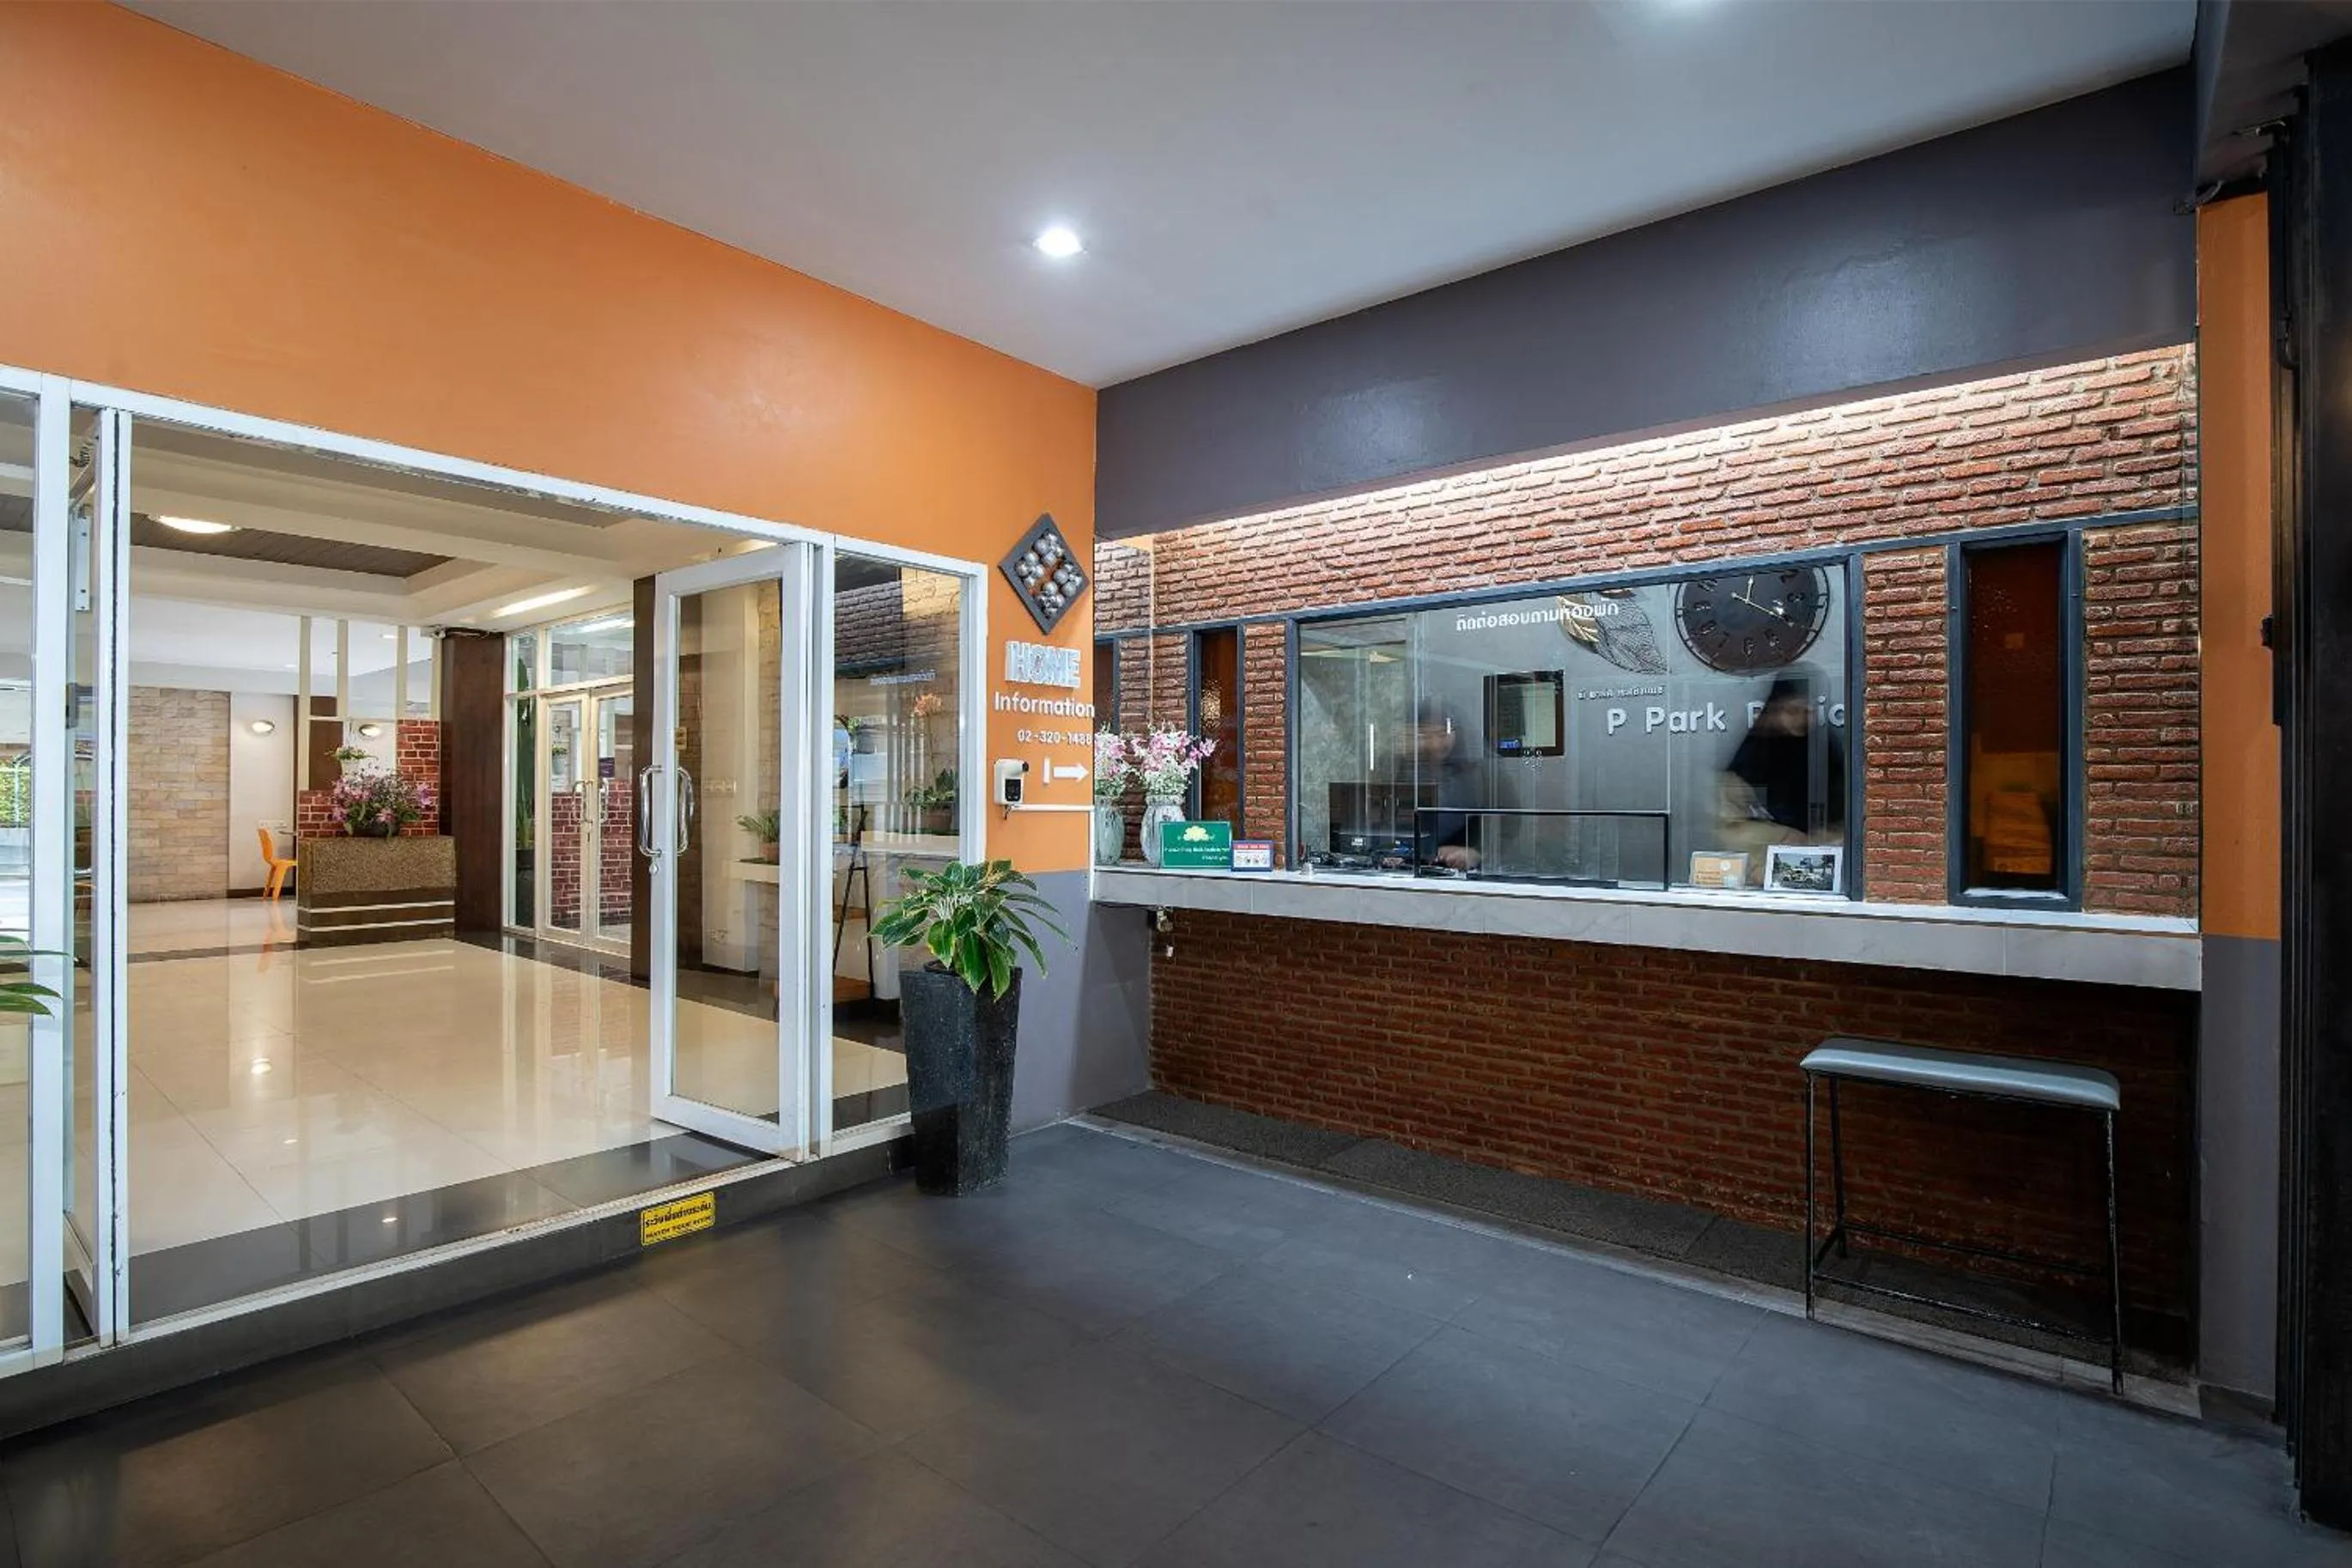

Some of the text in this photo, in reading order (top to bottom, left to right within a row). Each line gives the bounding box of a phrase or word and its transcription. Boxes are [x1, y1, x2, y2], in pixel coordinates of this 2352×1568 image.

[1005, 641, 1081, 689] HOME
[994, 690, 1095, 718] Information
[1607, 707, 1627, 734] P
[1645, 702, 1727, 732] Park
